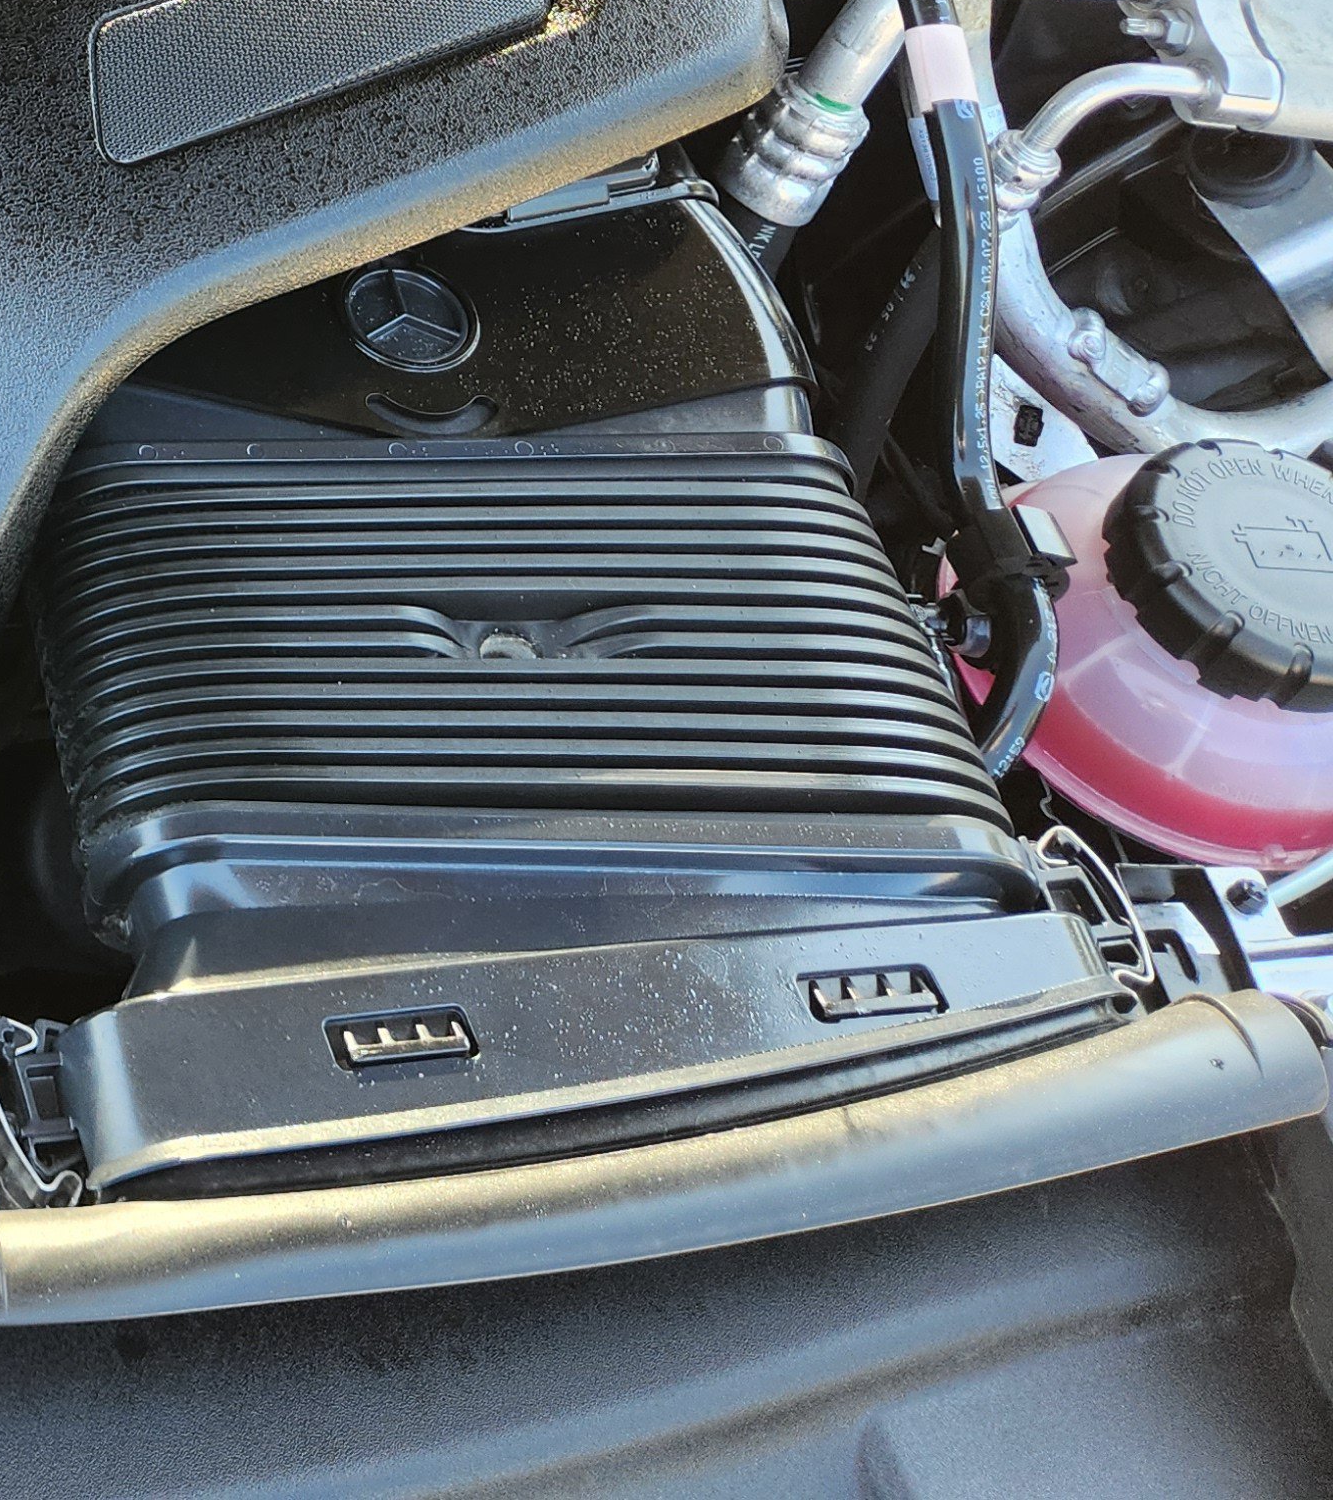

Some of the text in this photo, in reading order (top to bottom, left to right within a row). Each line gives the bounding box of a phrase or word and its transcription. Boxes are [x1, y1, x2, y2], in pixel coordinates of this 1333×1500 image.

[1208, 457, 1265, 480] OPEN
[1183, 467, 1213, 502] NOT
[1171, 500, 1196, 528] DO
[1185, 550, 1249, 606] NICHT
